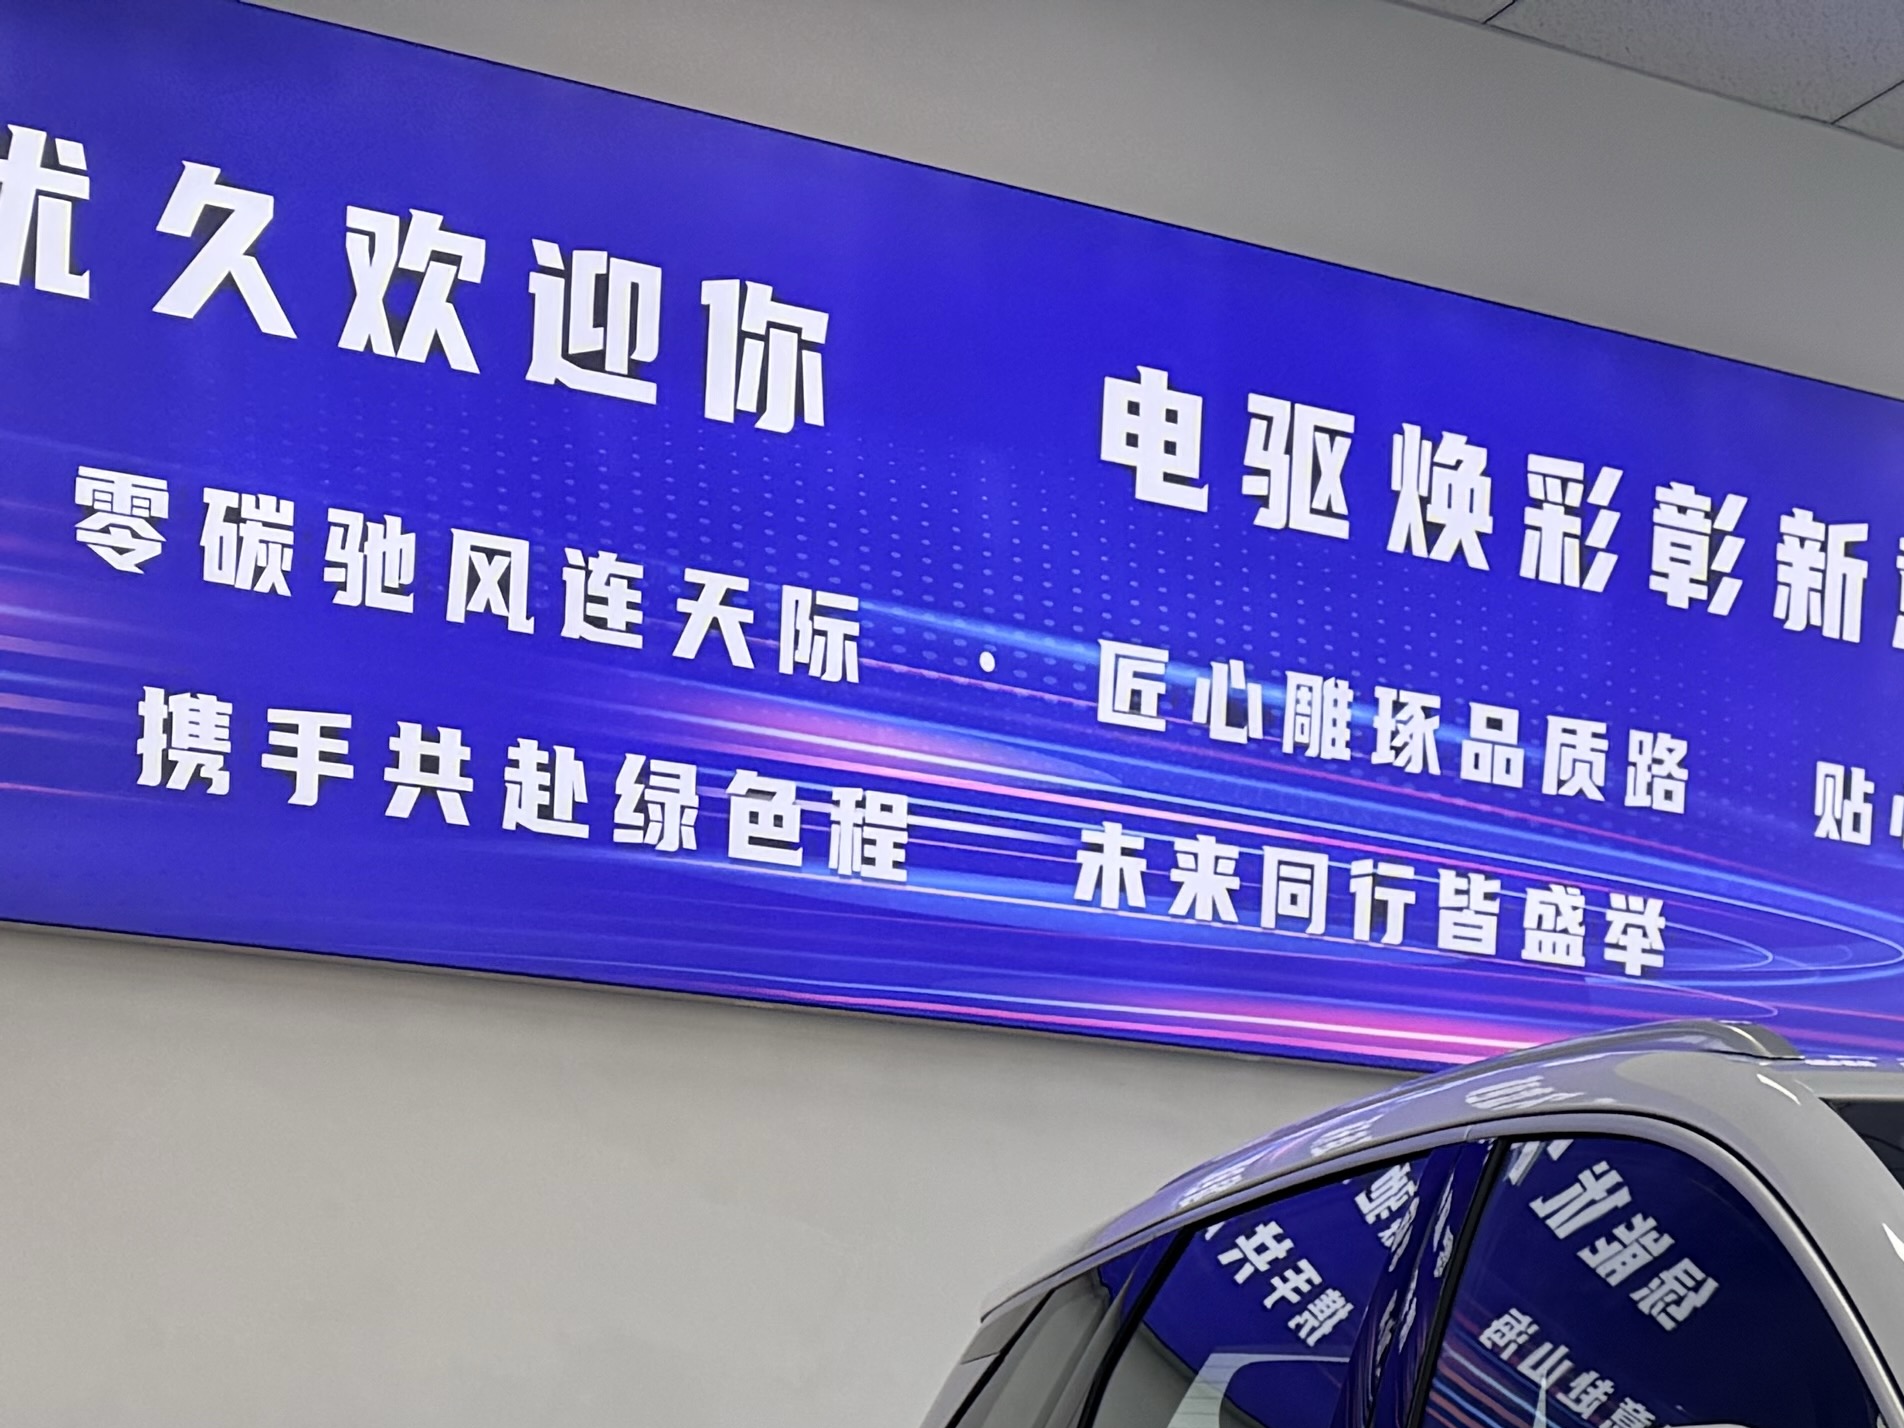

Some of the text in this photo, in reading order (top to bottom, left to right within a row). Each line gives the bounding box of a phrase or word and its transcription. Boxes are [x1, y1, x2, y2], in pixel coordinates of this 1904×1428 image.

[75, 467, 861, 685] 零碳驰风连天际
[1097, 640, 1690, 815] 匠心雕琢品质路
[137, 686, 1667, 977] 携手共赴绿色程 未来同行皆盛举
